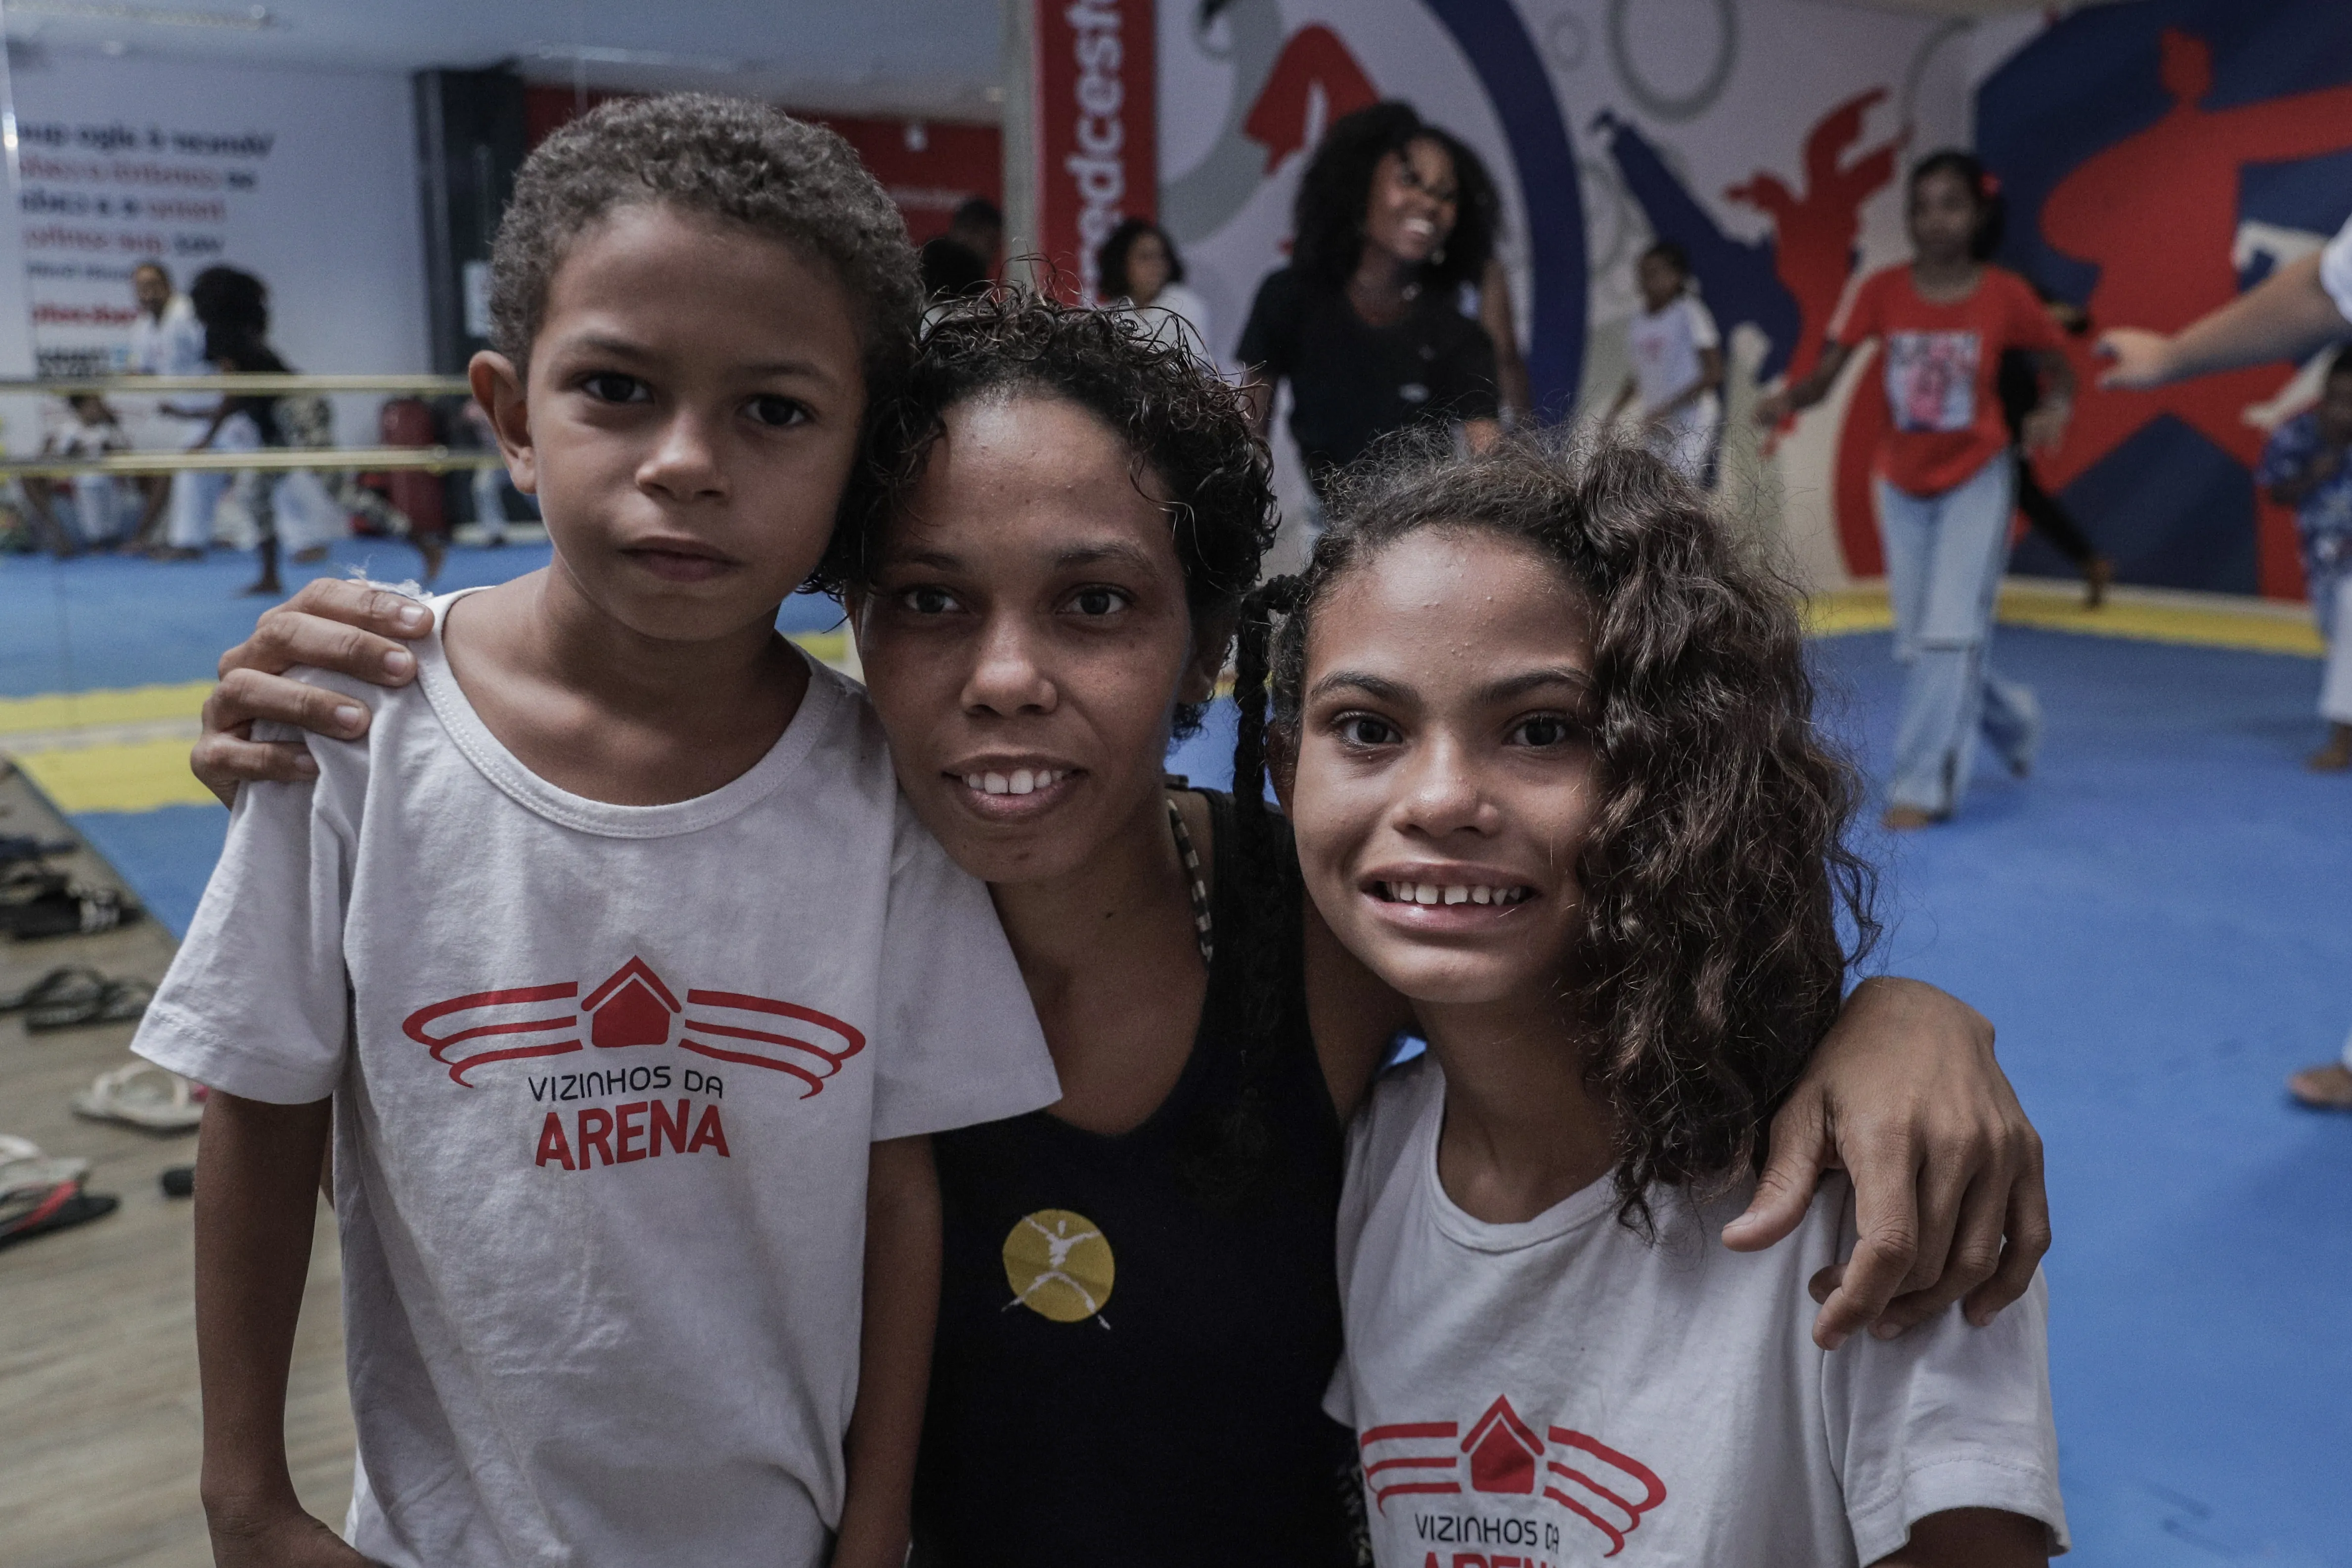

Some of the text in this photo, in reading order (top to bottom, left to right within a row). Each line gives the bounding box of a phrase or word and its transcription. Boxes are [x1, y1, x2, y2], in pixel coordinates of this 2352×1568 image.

[528, 1066, 723, 1102] VIZINHOS DA
[535, 1098, 730, 1170] ARENA
[1415, 1513, 1559, 1553] VIZINHOS DA
